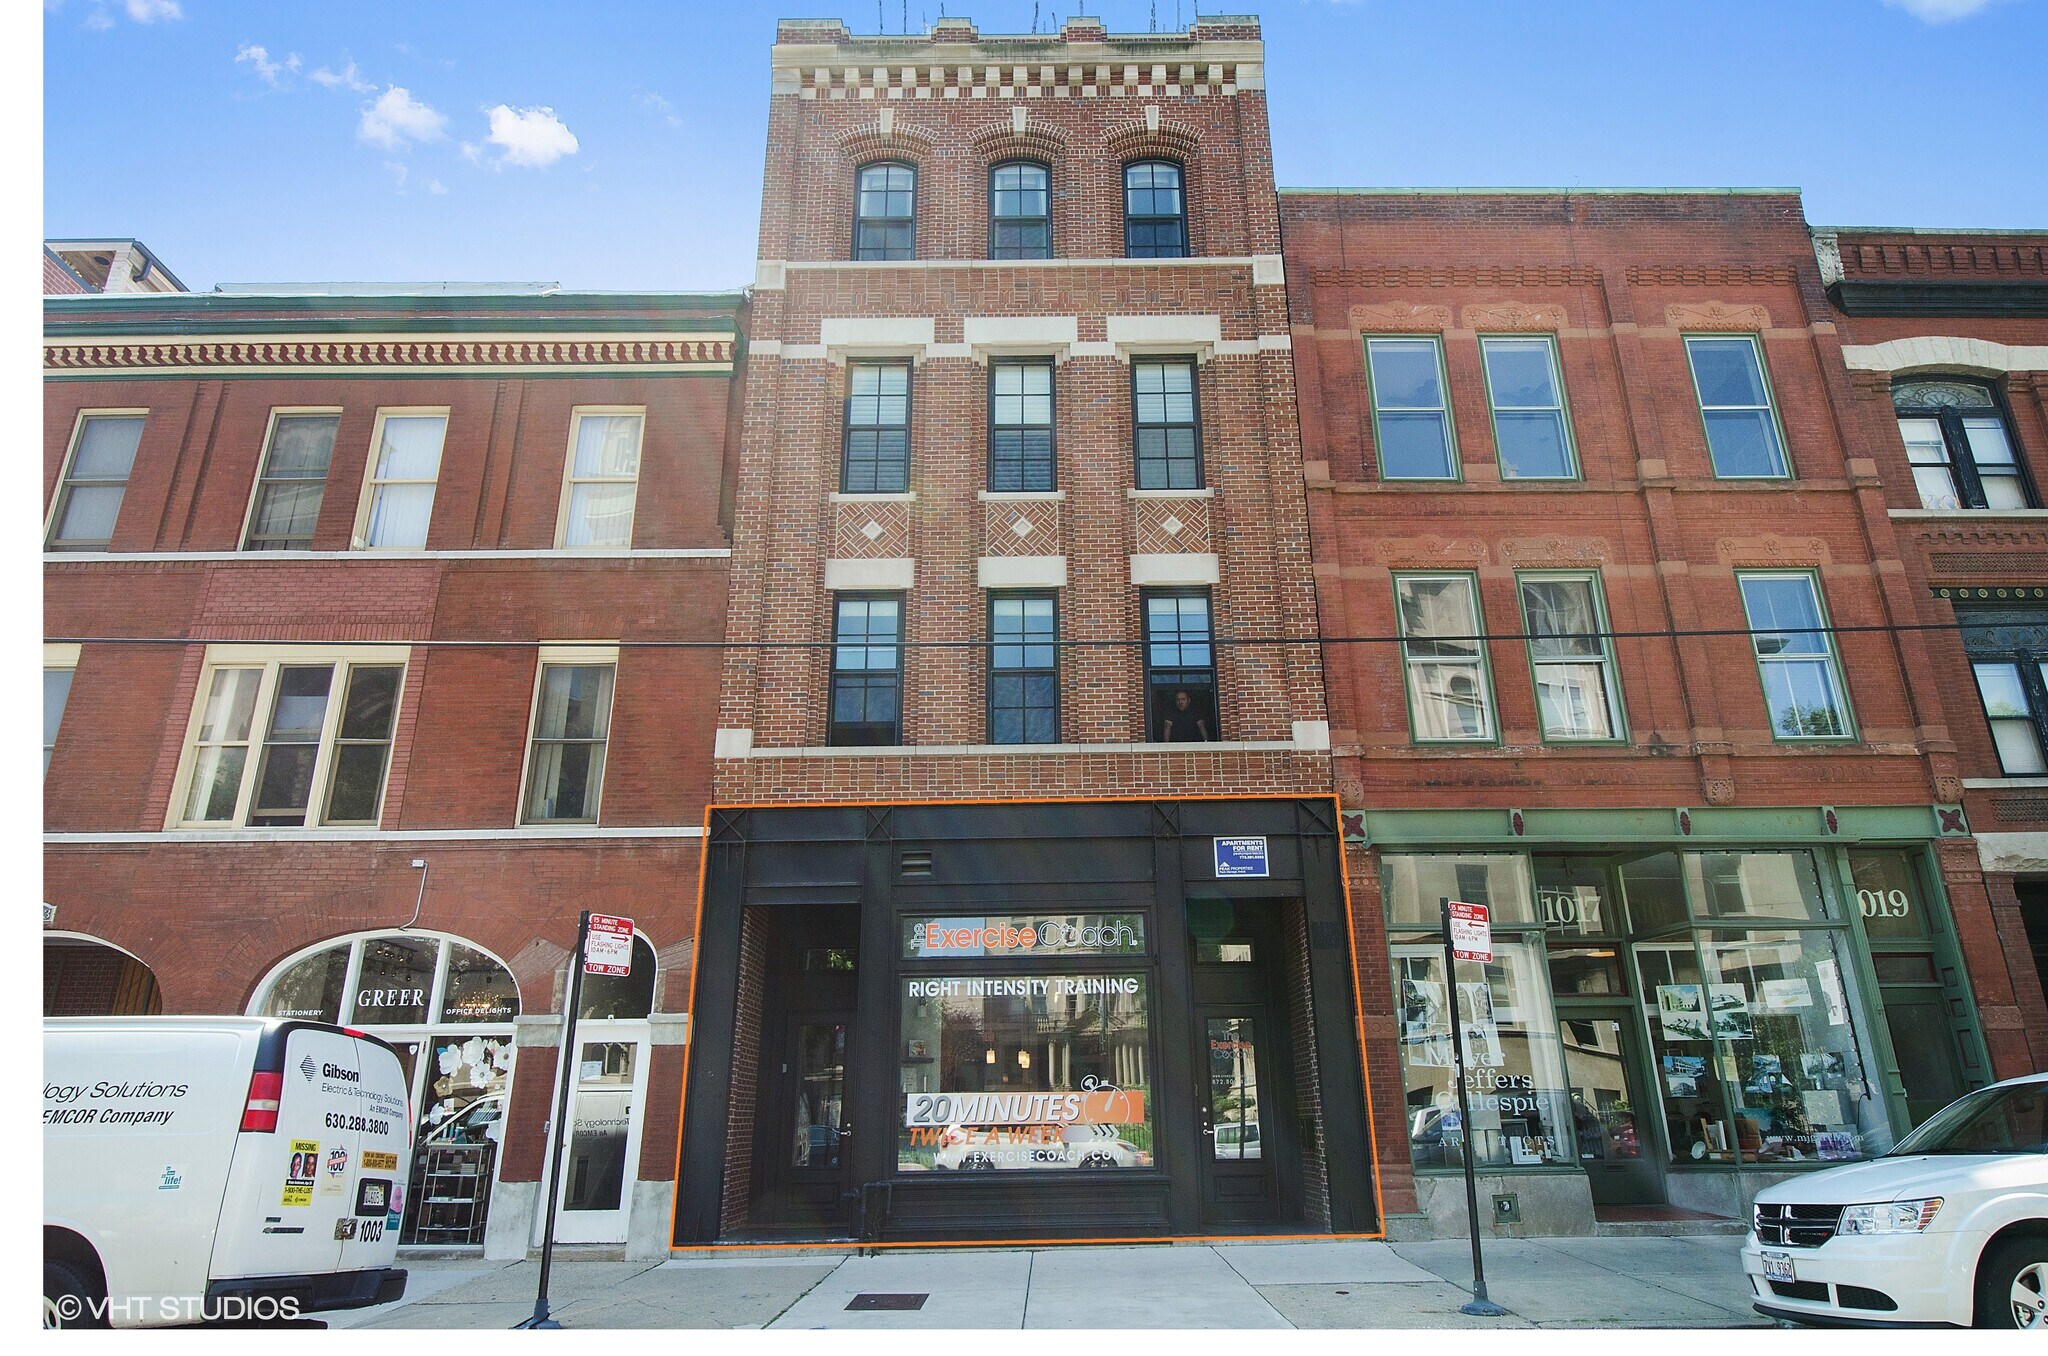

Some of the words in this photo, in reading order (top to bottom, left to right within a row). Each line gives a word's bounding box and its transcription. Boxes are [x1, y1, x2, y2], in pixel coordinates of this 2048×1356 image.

[1452, 911, 1472, 919] STANDING
[1541, 896, 1601, 923] 1017
[593, 924, 616, 932] STANDING
[601, 918, 618, 926] MINUTE
[591, 941, 613, 949] FLASHING
[925, 923, 1037, 949] Exercise
[1472, 952, 1489, 960] ZONE
[588, 963, 605, 972] TOW
[607, 965, 626, 974] ZONE
[909, 980, 960, 997] RIGHT
[967, 979, 1050, 996] INTENSITY
[1055, 978, 1139, 995] TRAINING
[358, 988, 424, 1007] GREER
[446, 1007, 472, 1015] OFFICE
[474, 1007, 512, 1015] DELIGHTS
[1428, 1047, 1505, 1071] Myer
[322, 1063, 360, 1083] Gibson
[90, 1081, 189, 1098] Solutions
[321, 1082, 347, 1096] Electric
[348, 1087, 353, 1096] &
[354, 1087, 384, 1104] Technology
[384, 1094, 404, 1108] Solutions
[1436, 1090, 1549, 1116] Gllespie
[100, 1108, 175, 1126] Company
[325, 1112, 389, 1136] 630.288.3800
[910, 1126, 978, 1147] TWICE
[984, 1126, 1001, 1145] A
[1007, 1126, 1067, 1145] WEEK
[295, 1142, 317, 1151] MISSING
[359, 1220, 383, 1242] 1003
